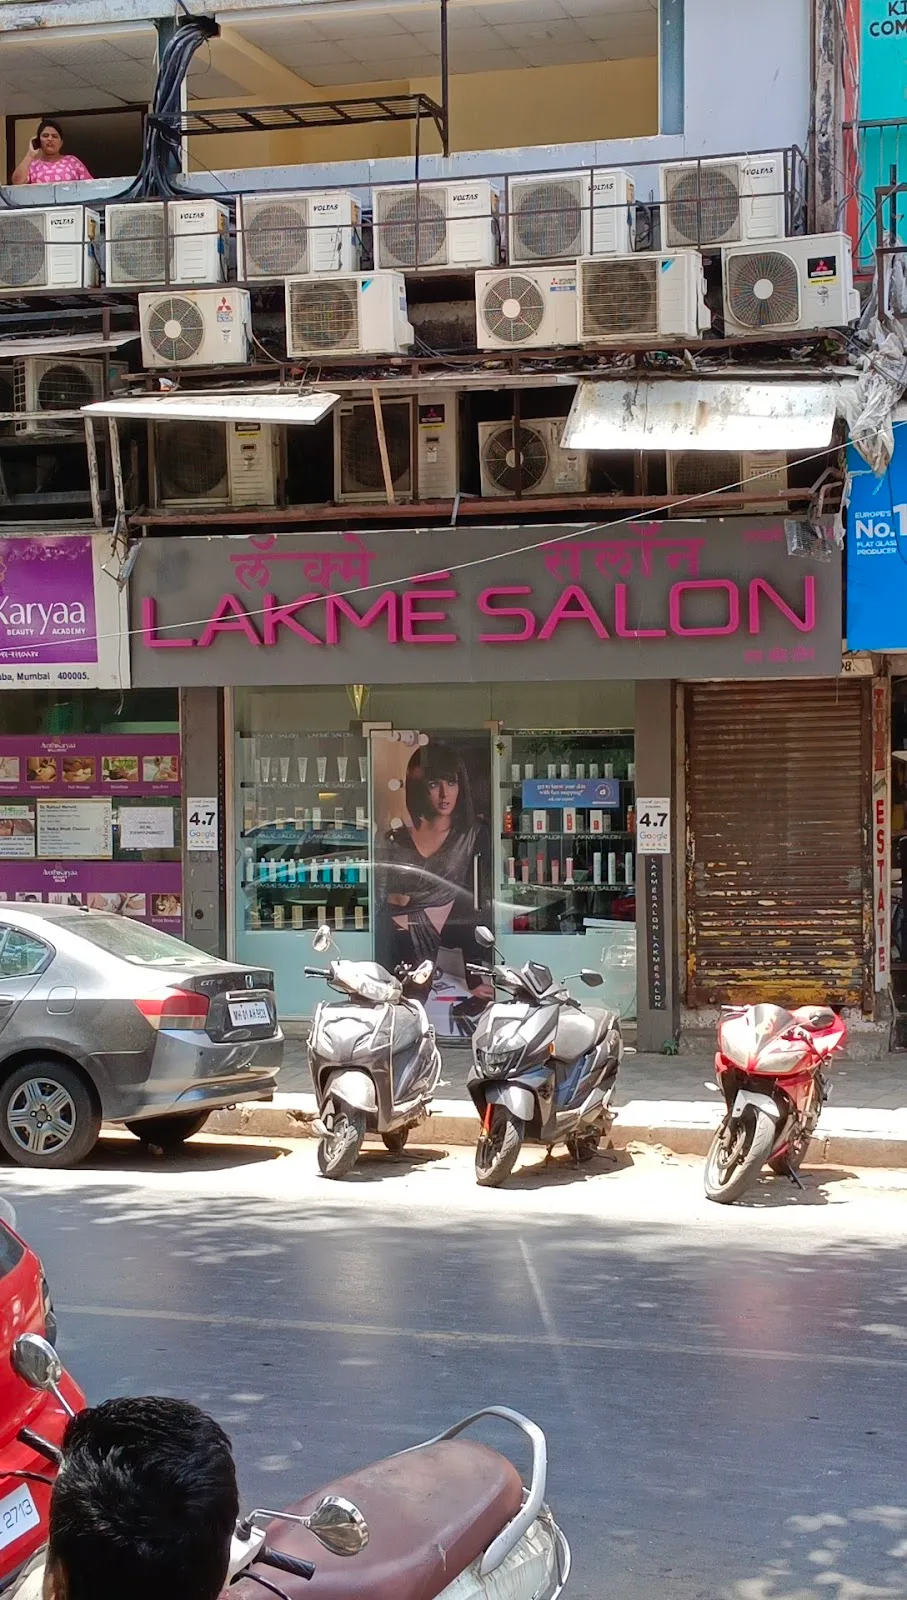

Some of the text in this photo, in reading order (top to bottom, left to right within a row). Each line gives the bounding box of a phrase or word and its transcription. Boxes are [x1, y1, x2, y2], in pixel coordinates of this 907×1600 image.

[746, 167, 774, 176] VOLTAS
[588, 183, 614, 191] VOLTAS
[452, 193, 479, 201] VOLTAS
[313, 204, 338, 212] VOLTAS
[180, 212, 205, 220] VOLTAS
[855, 510, 892, 519] EUROPE'S
[856, 547, 898, 556] PRODUCER
[143, 571, 816, 647] LAKMÉ SALON
[7, 627, 86, 636] BEAUTY ACADEMY
[189, 812, 216, 825] 4.7
[639, 812, 668, 827] 4.7
[190, 830, 216, 840] Google
[640, 831, 668, 841] Google
[876, 799, 886, 973] ESTATE
[3, 1498, 33, 1529] 2713
